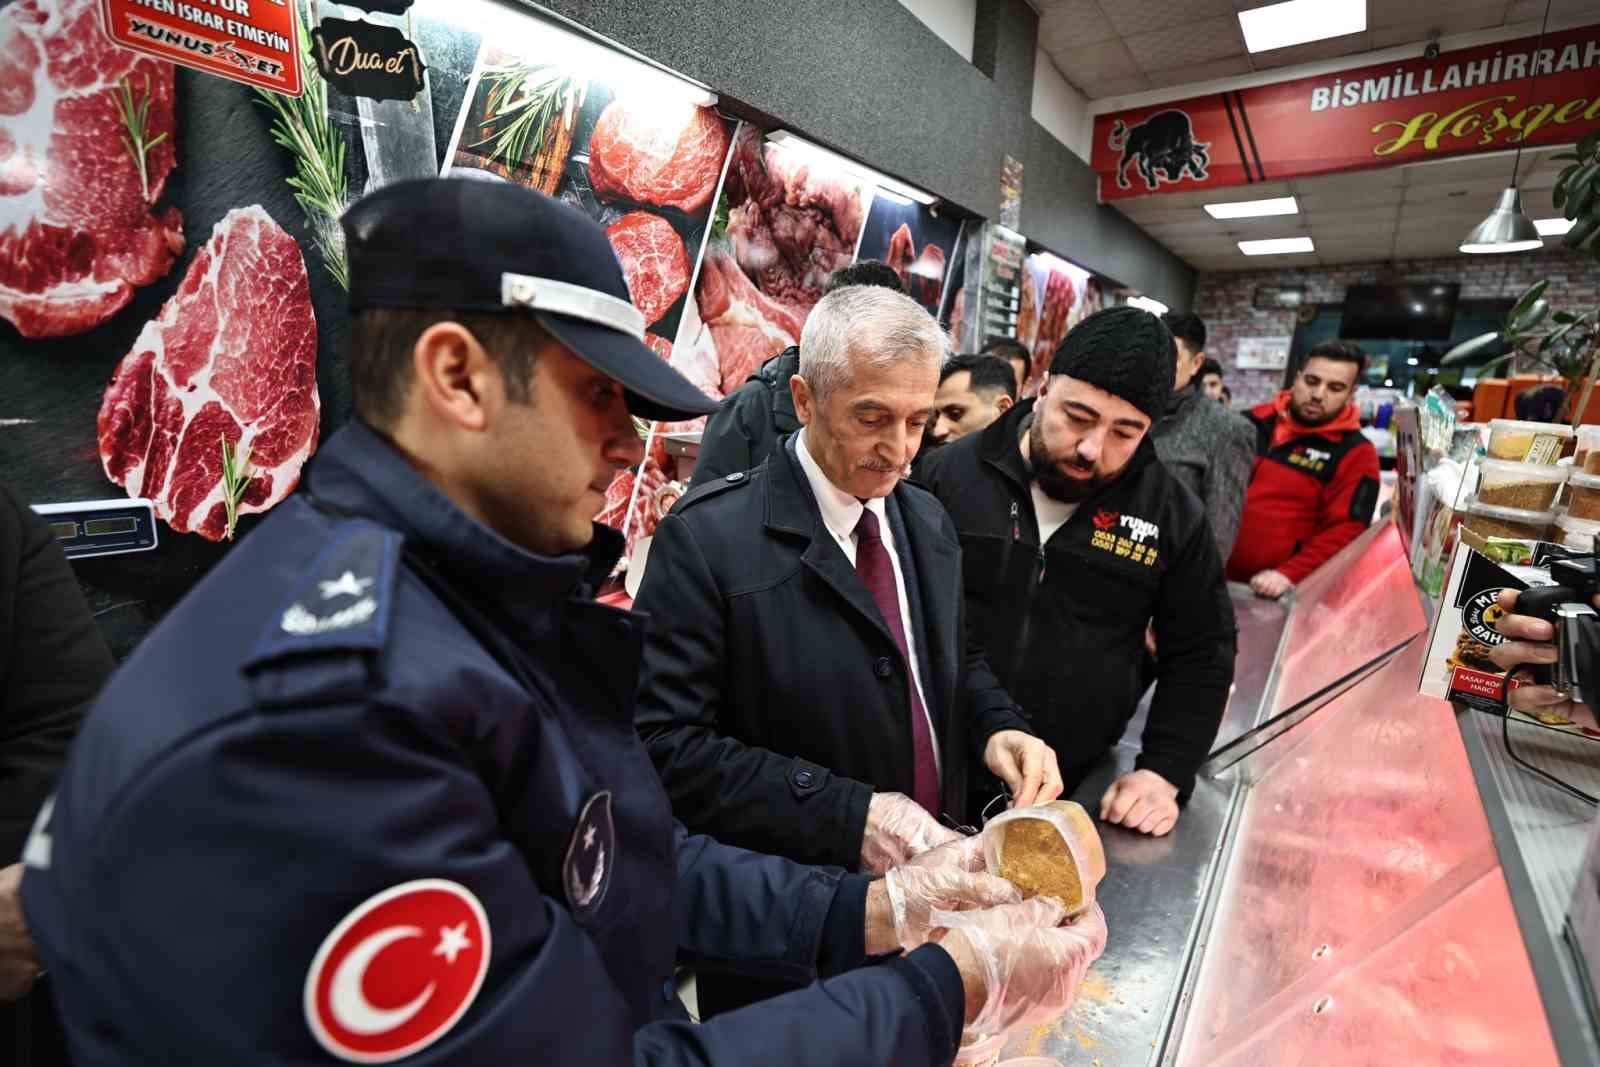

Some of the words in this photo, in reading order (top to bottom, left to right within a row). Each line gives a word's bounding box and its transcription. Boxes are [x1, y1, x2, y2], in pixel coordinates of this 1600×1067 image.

[131, 20, 215, 56] YUNUS
[256, 60, 283, 76] ET
[177, 2, 223, 31] ISRAR
[227, 20, 290, 53] ETMEYİN
[328, 35, 384, 75] Dua
[385, 48, 410, 74] et
